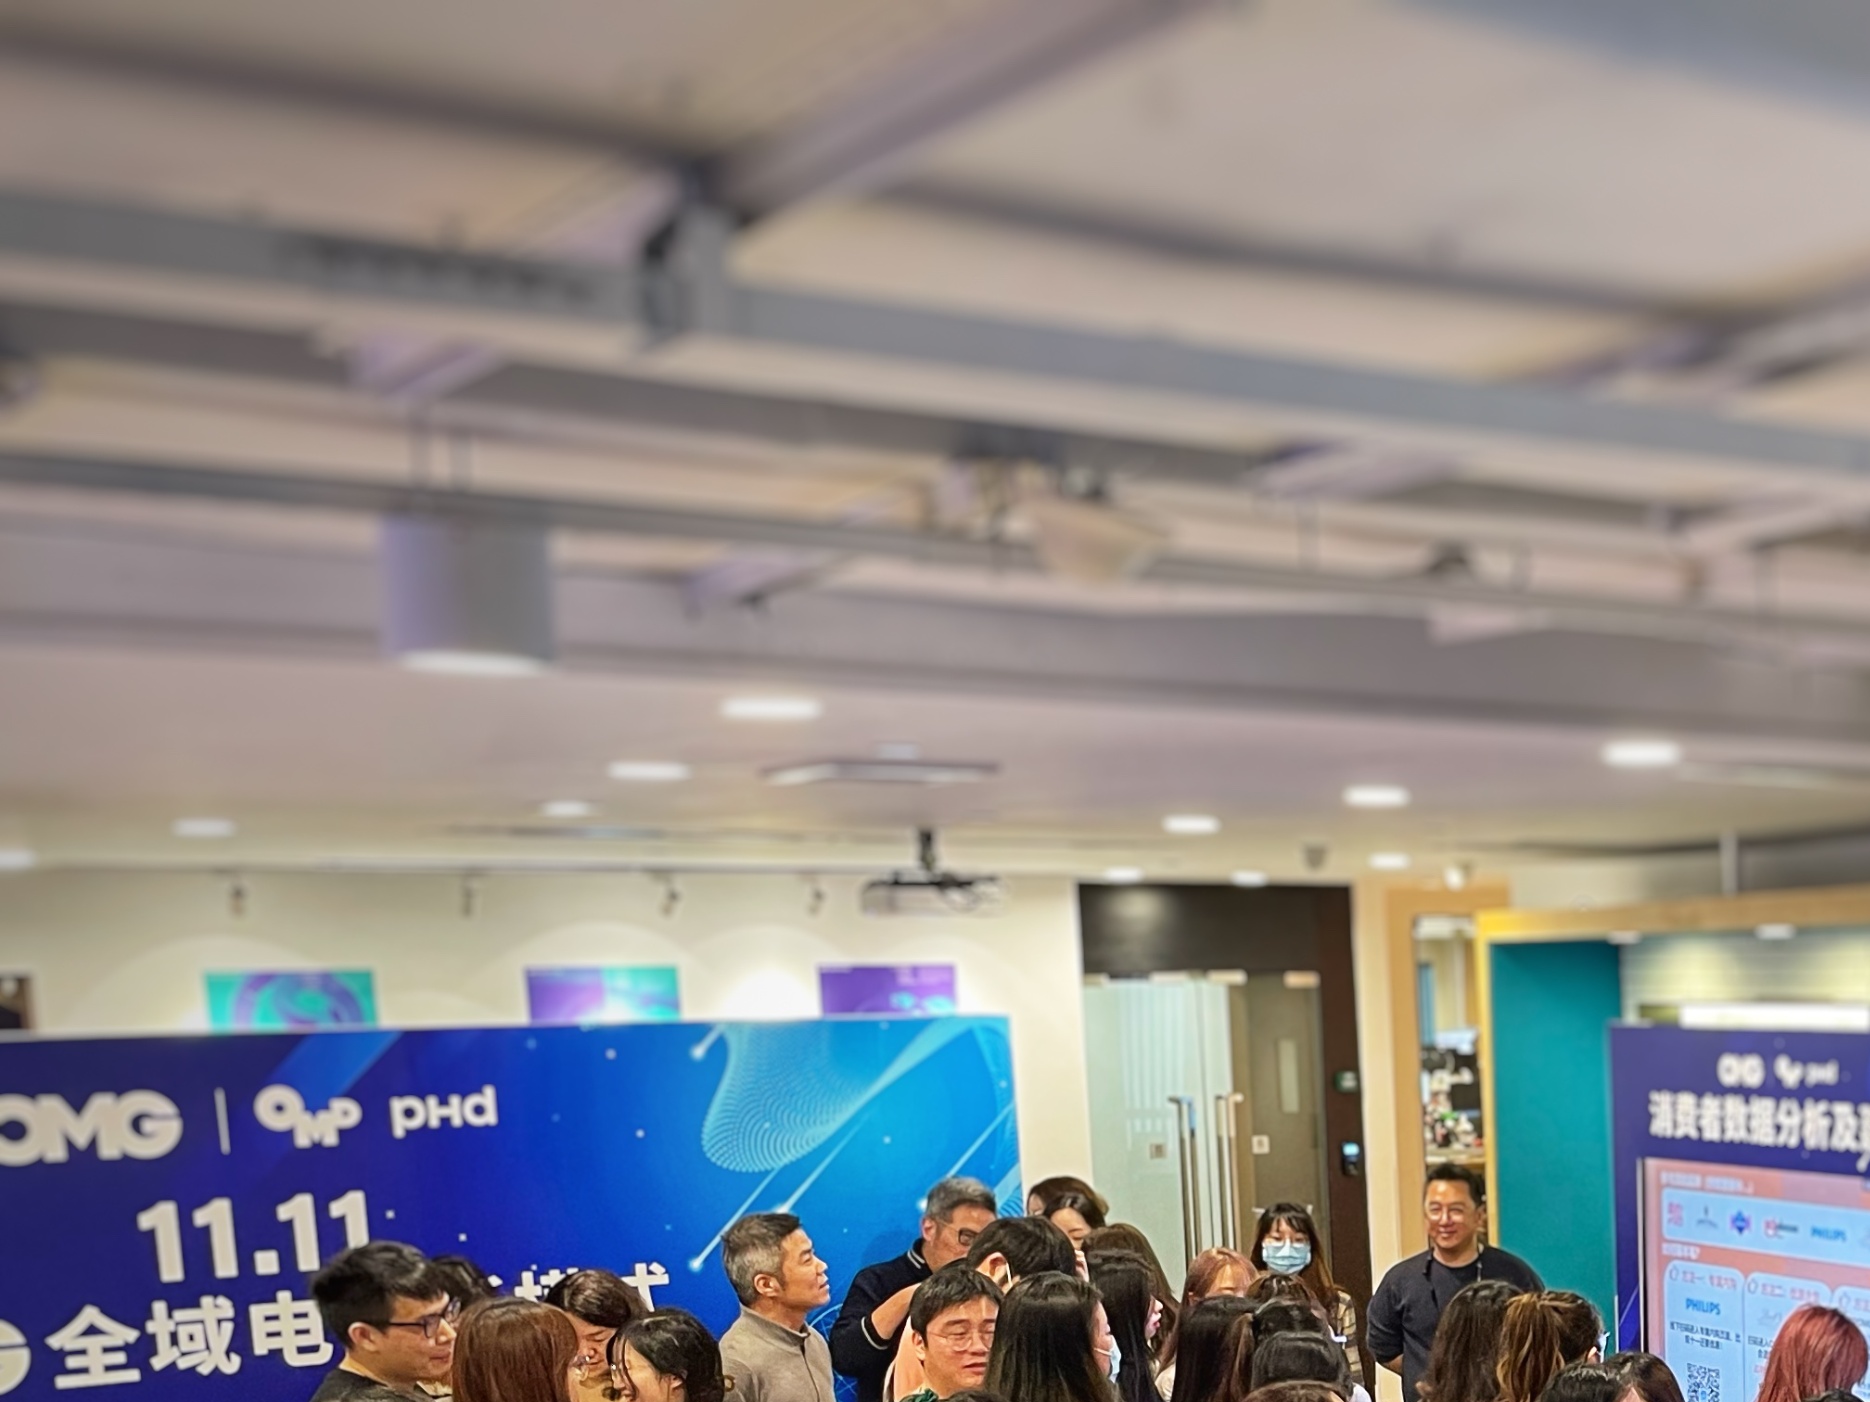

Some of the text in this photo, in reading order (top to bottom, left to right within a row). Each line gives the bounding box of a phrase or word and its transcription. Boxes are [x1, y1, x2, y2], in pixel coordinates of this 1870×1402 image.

[0, 1089, 183, 1167] OMG
[136, 1190, 371, 1284] 11.11
[1685, 1296, 1722, 1316] PHILIPS
